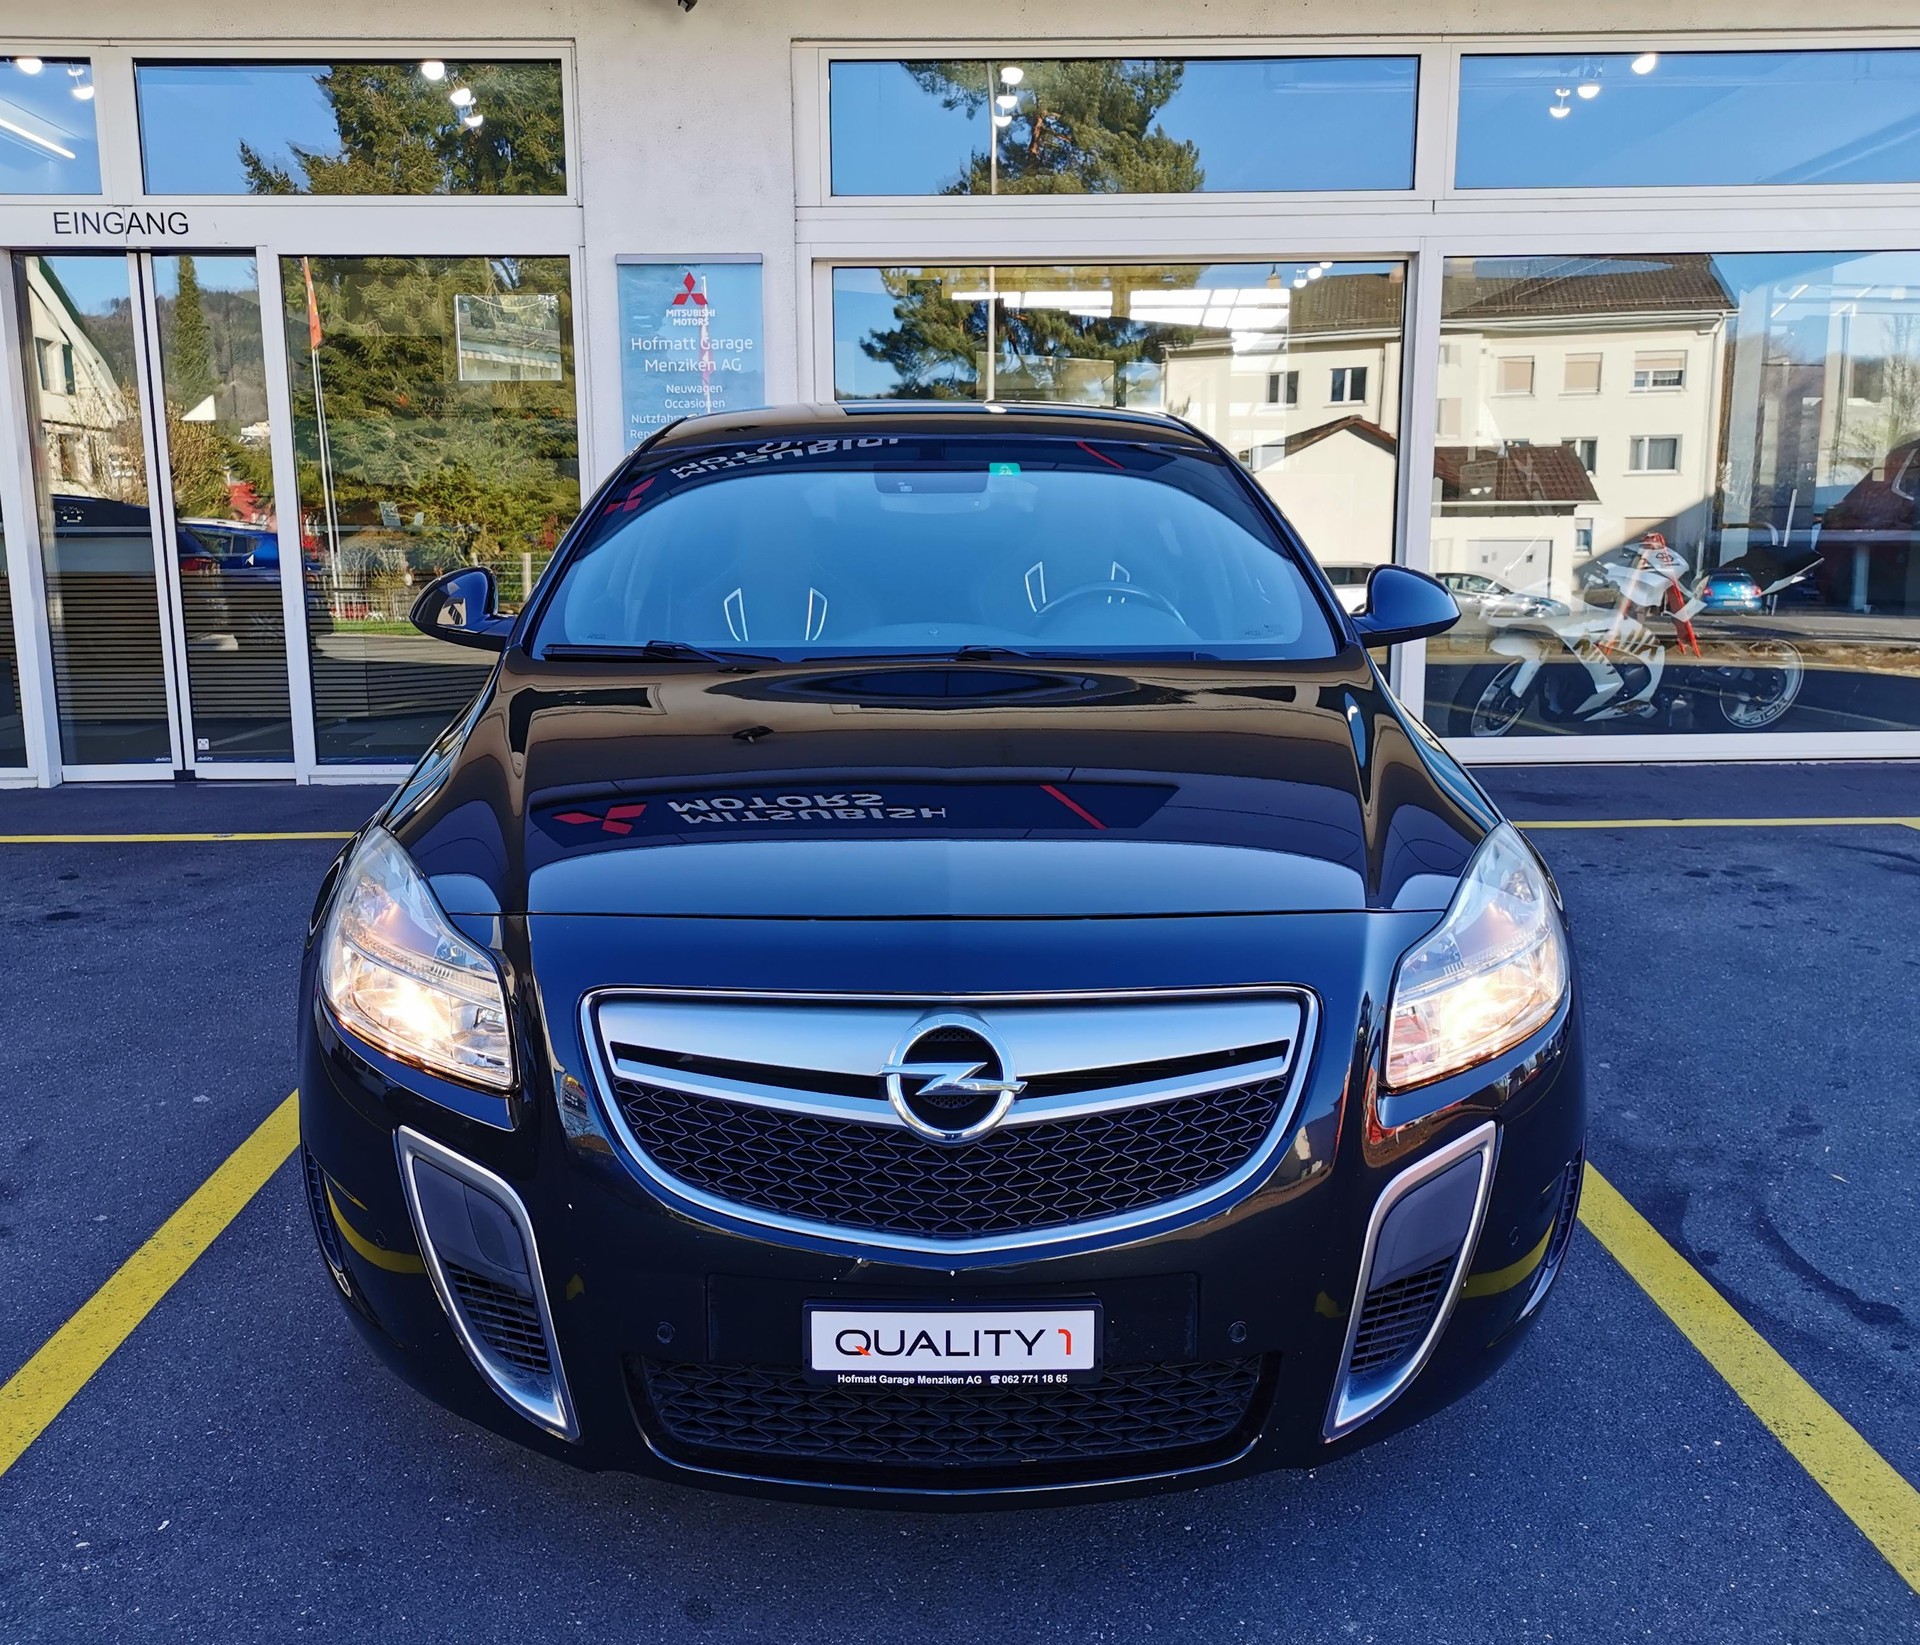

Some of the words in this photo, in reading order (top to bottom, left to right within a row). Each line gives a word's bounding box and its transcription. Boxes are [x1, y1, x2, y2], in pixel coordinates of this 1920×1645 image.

[53, 211, 189, 235] EINGANG
[666, 309, 716, 317] MITSUBISHI
[673, 318, 710, 326] MOTORS
[631, 336, 697, 351] Hofmatt
[700, 337, 753, 353] Garage
[644, 359, 717, 372] Menziken
[721, 358, 742, 371] AG
[666, 384, 723, 395] Neuwagen
[664, 399, 726, 409] Occasionen
[835, 1328, 1046, 1357] QUALITY
[1057, 1328, 1072, 1356] 1
[837, 1374, 877, 1384] Hofmatt
[879, 1375, 915, 1386] Garage
[917, 1375, 964, 1385] Menziken
[965, 1375, 982, 1385] AG
[1001, 1374, 1020, 1384] 062
[1021, 1374, 1039, 1384] 771
[1042, 1374, 1054, 1384] 18
[1055, 1374, 1068, 1383] 65
